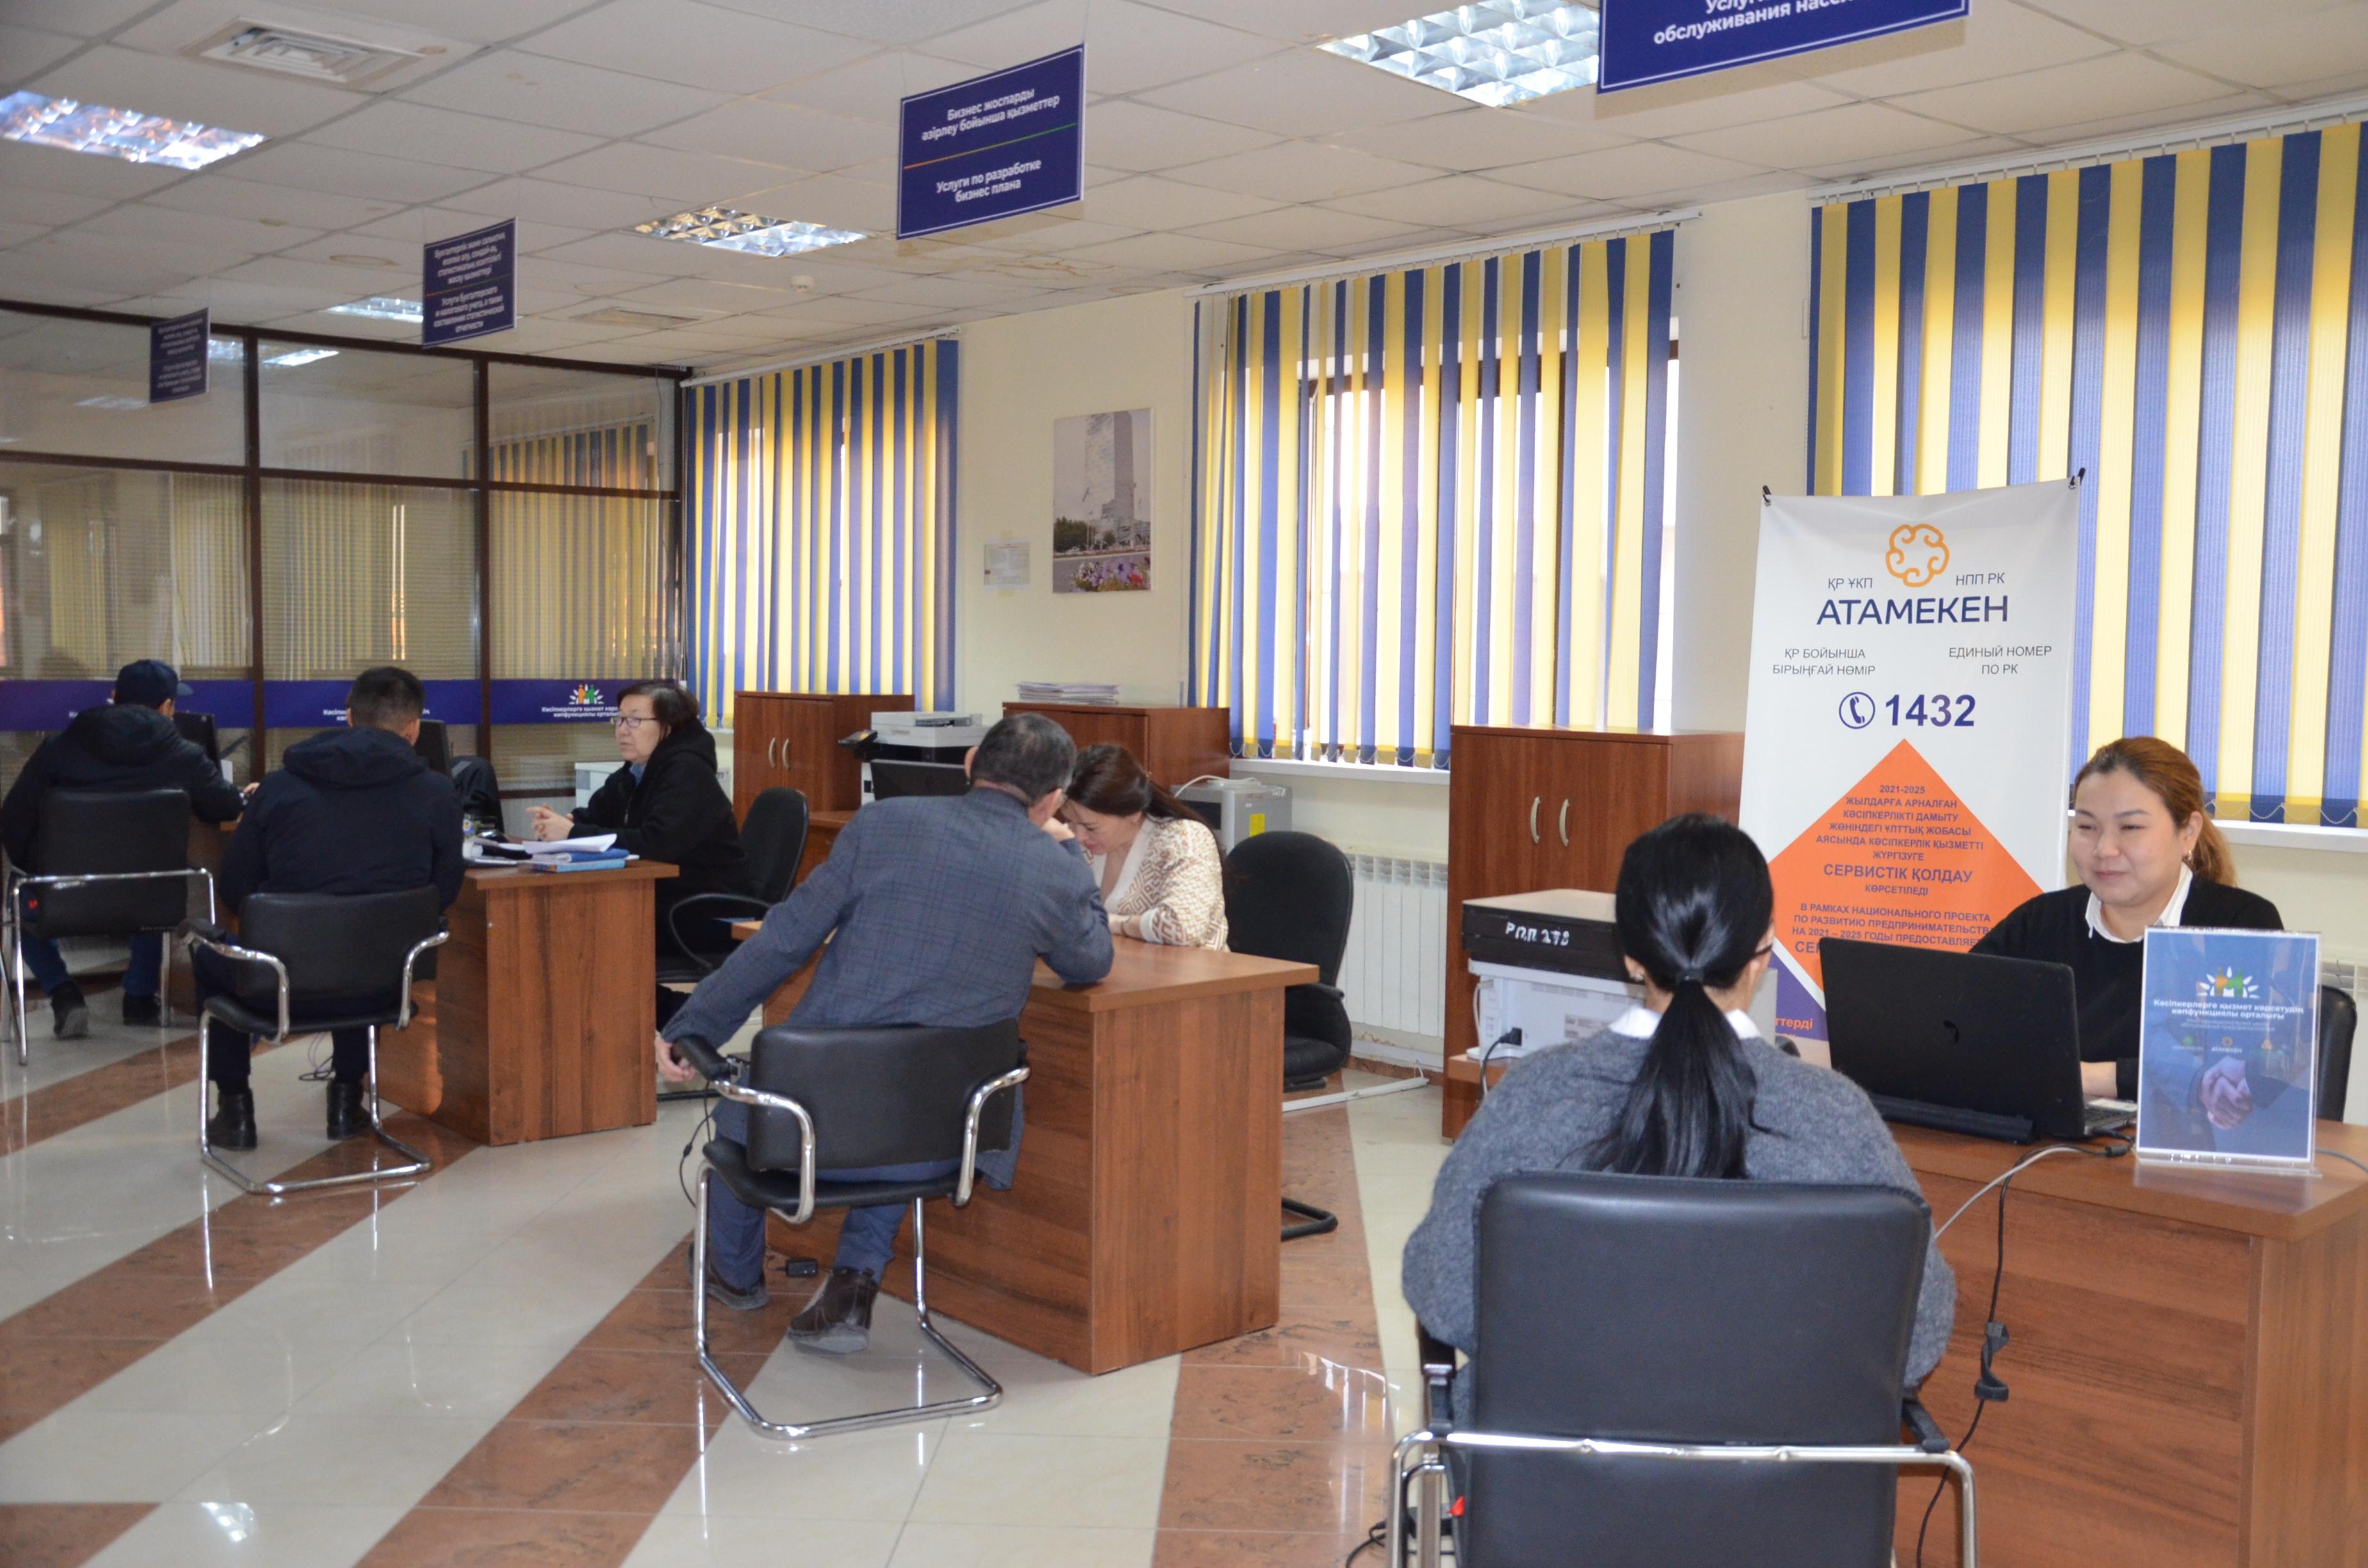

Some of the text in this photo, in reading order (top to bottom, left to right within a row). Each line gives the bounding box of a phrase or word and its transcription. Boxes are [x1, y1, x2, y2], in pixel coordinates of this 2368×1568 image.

[1706, 0, 1763, 13] Услу
[1654, 2, 1791, 45] обслуживания
[946, 88, 1035, 122] Бизнес жоспарды
[959, 109, 1006, 132] бойынша
[1007, 95, 1060, 120] қызметтер
[936, 159, 1042, 193] Услуги по разработке
[955, 179, 1021, 203] бизнес плана
[1828, 578, 1845, 591] ҚР
[1955, 572, 2005, 586] НПП РК
[1816, 594, 2009, 626] АТАМЕКЕН
[1784, 646, 1866, 660] ҚР БОЙЫНША
[1948, 644, 2053, 659] ЕДИНЫЙ НОМЕР
[1772, 662, 1877, 678] БІРЫҢҒАЙ НӨМІР
[1981, 664, 2019, 675] ПО РК
[1885, 693, 1977, 728] 1432
[1879, 785, 1926, 794] 2021-2025
[1846, 797, 1958, 809] ЖЫЛДАРҒА АРНАЛҒАН
[1916, 812, 1959, 822] ДАМЫТУ
[1829, 822, 1882, 833] ЖӨНІНДЕГІ
[1927, 826, 1971, 837] ЖОБАСЫ
[1816, 835, 1984, 851] АЯСЫНДА КӘСІПКЕРЛІК ҚЫЗМЕТТІ
[1823, 863, 1973, 884] СЕРВИСТІК ҚОЛДАУ
[1864, 884, 1928, 896] КӨРСЕТІЛЕДІ
[1800, 902, 1991, 922] В РАМКАХ НАЦИОНАЛЬНОГО ПРОЕКТА
[1793, 914, 1990, 935] ПО РАЗВИТИЮ ПРЕДПРИНИМАТЕЛЬСТВ
[1791, 926, 1806, 936] НА
[1808, 927, 1829, 938] 2021
[1840, 929, 1862, 939] 2025
[1864, 931, 1893, 942] ГОДЫ
[1896, 933, 1978, 947] ПРЕДОСТАВЛЯЕ
